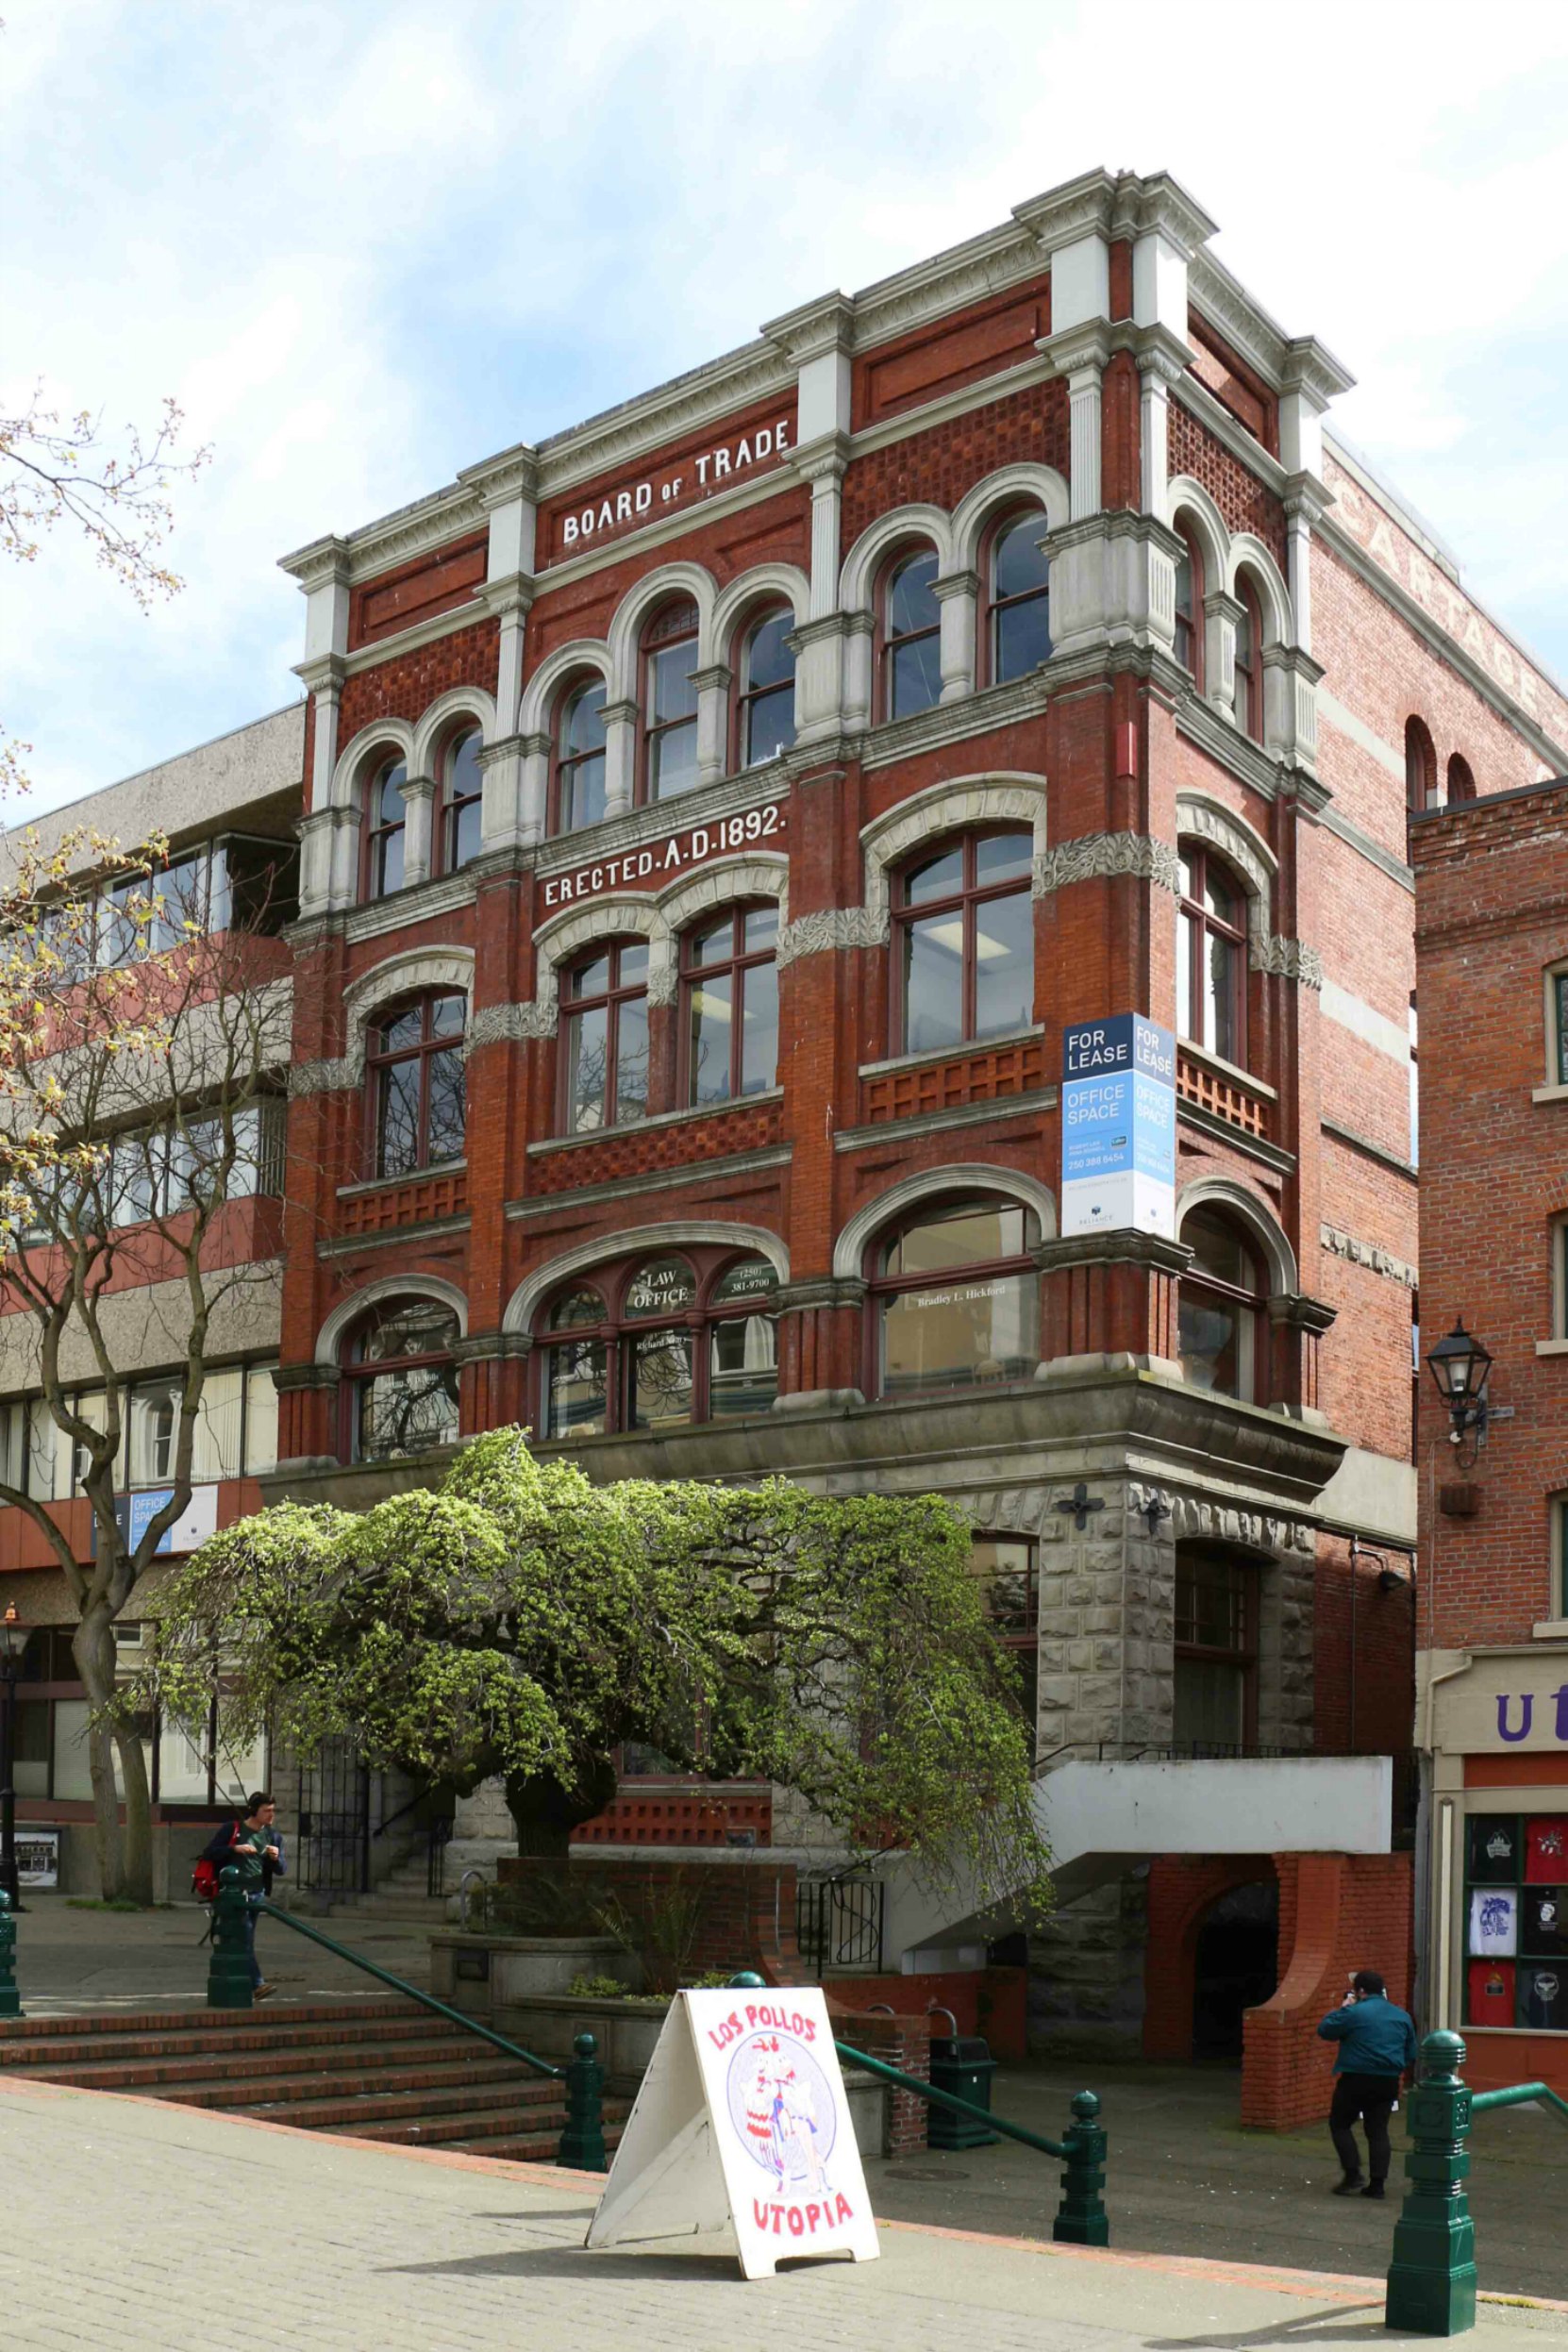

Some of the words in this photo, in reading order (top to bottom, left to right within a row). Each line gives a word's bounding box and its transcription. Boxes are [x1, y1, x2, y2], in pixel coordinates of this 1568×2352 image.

[563, 483, 652, 544] BOARD
[662, 477, 682, 501] OF
[695, 420, 789, 484] TRADE
[1332, 478, 1538, 713] CARTAGE
[1068, 1029, 1105, 1052] FOR
[1137, 1026, 1159, 1051] FOR
[1068, 1043, 1127, 1071] LEASE
[1137, 1044, 1172, 1076] LEASE
[1068, 1084, 1126, 1108] OFFICE
[1068, 1102, 1120, 1126] SPACE
[646, 1270, 676, 1288] LAW
[740, 1267, 762, 1279] (250)
[634, 1287, 688, 1309] OFFICE
[917, 1293, 951, 1308] Bradley
[134, 1496, 166, 1510] OFFICE
[709, 2011, 743, 2052] LOS
[745, 2004, 817, 2043] POLLOS
[753, 2192, 855, 2237] UTOPIA
